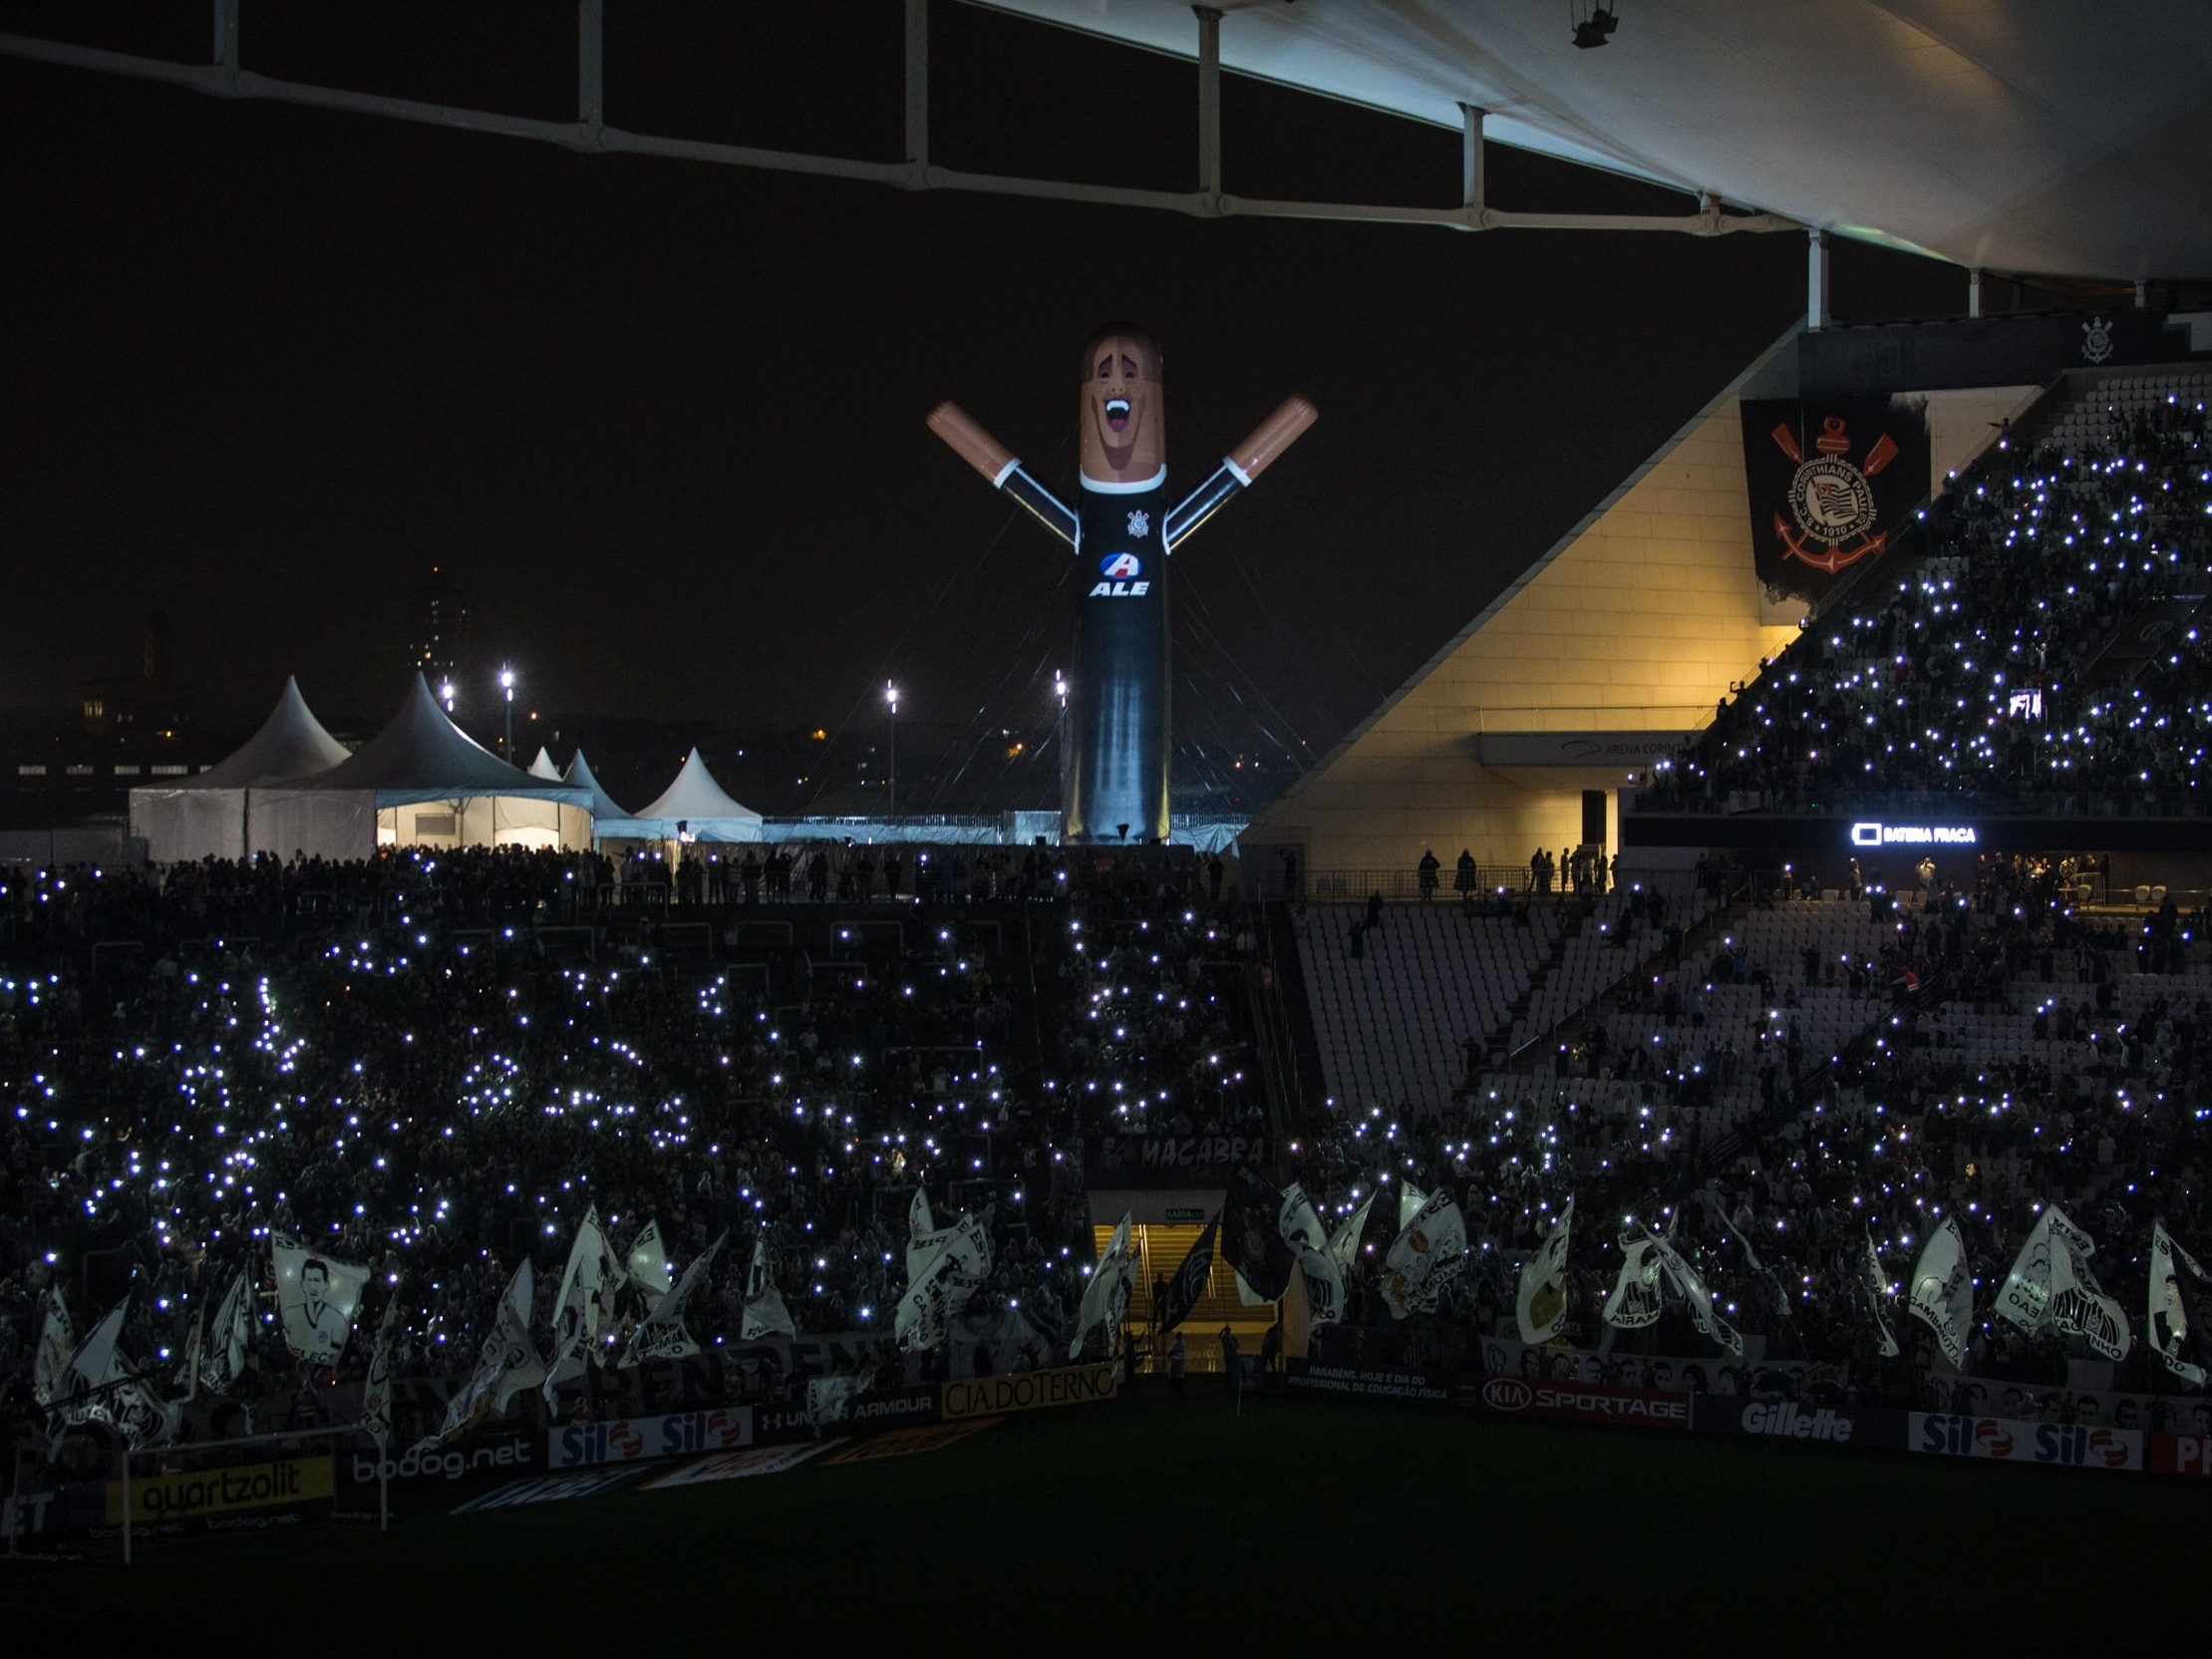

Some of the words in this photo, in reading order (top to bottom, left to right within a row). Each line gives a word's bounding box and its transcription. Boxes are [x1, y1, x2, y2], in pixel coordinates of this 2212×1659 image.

[1796, 464, 1853, 501] CORINTHIANS
[1823, 525, 1847, 537] 1910
[1089, 581, 1150, 597] ALE
[1606, 744, 1640, 755] ARENA
[1883, 827, 1933, 842] BATERIA
[1142, 1136, 1264, 1168] MACABRA
[1288, 1376, 1351, 1392] PROFISSIONAL
[1353, 1383, 1365, 1393] DE
[1367, 1382, 1417, 1398] EDUCAÇÃO
[1360, 1370, 1384, 1383] HOJE
[1395, 1374, 1410, 1385] DIA
[1412, 1375, 1425, 1386] DO
[854, 1396, 933, 1419] ARMOUR
[1491, 1385, 1524, 1406] KIA
[1536, 1389, 1688, 1420] SPORTAGE
[662, 1409, 705, 1454] Sil
[1740, 1401, 1853, 1442] Gillette
[1923, 1415, 1973, 1455] Sil
[353, 1437, 531, 1484] bodog.net
[561, 1422, 608, 1467] Sil
[2036, 1424, 2085, 1465] Sil
[143, 1462, 300, 1514] quartzolit
